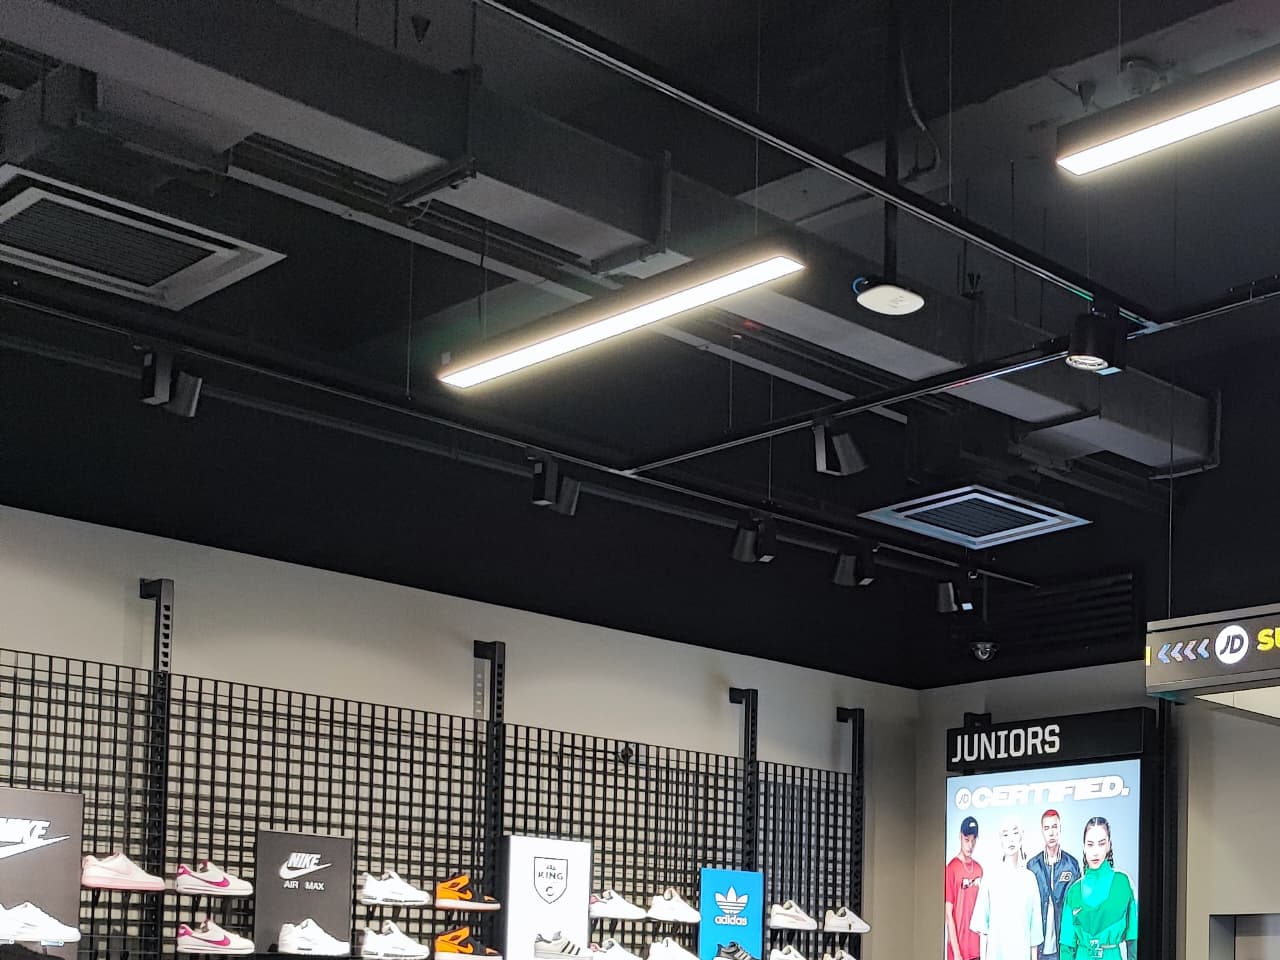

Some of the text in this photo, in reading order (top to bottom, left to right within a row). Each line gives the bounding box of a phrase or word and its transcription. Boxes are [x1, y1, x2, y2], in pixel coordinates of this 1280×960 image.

[951, 723, 1060, 763] JUNIORS
[287, 852, 321, 868] NIKE
[538, 871, 564, 881] KING
[283, 880, 325, 891] AIR MAX
[714, 914, 748, 926] adidas
